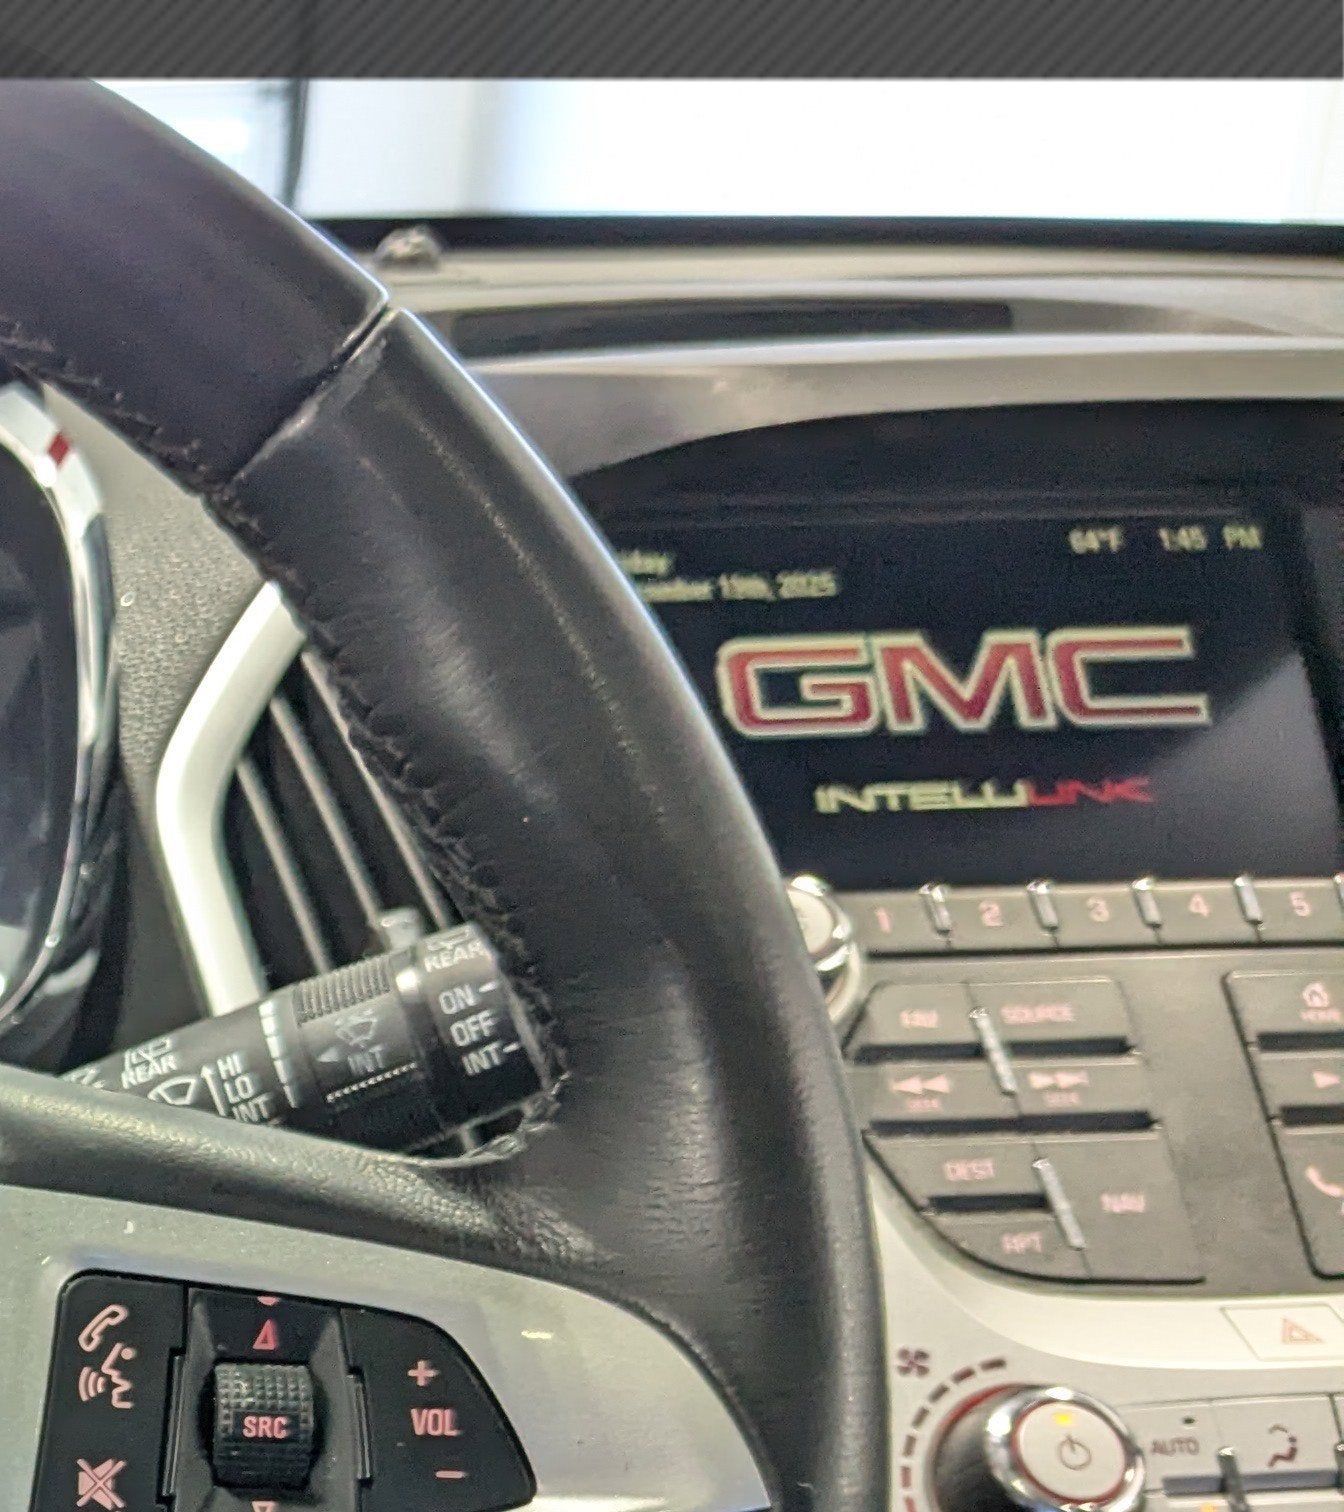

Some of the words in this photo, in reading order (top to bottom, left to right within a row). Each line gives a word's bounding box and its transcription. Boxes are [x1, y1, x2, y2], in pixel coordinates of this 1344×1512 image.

[716, 625, 1209, 737] GMC
[979, 901, 1003, 926] 2
[1087, 898, 1110, 922] 3
[1188, 894, 1209, 918] 4
[1289, 891, 1311, 917] 5
[874, 907, 891, 933] 1
[439, 984, 479, 1015] ON
[450, 1009, 498, 1047] OFF
[121, 1053, 180, 1090] REAR
[217, 1052, 244, 1080] HI
[347, 1044, 385, 1075] INT
[462, 1041, 503, 1076] INT
[224, 1076, 255, 1104] LO
[232, 1091, 276, 1123] INT
[943, 1157, 998, 1182] DEST
[243, 1415, 290, 1441] SRC
[410, 1407, 461, 1438] VOL
[1151, 1438, 1200, 1456] AUTO
